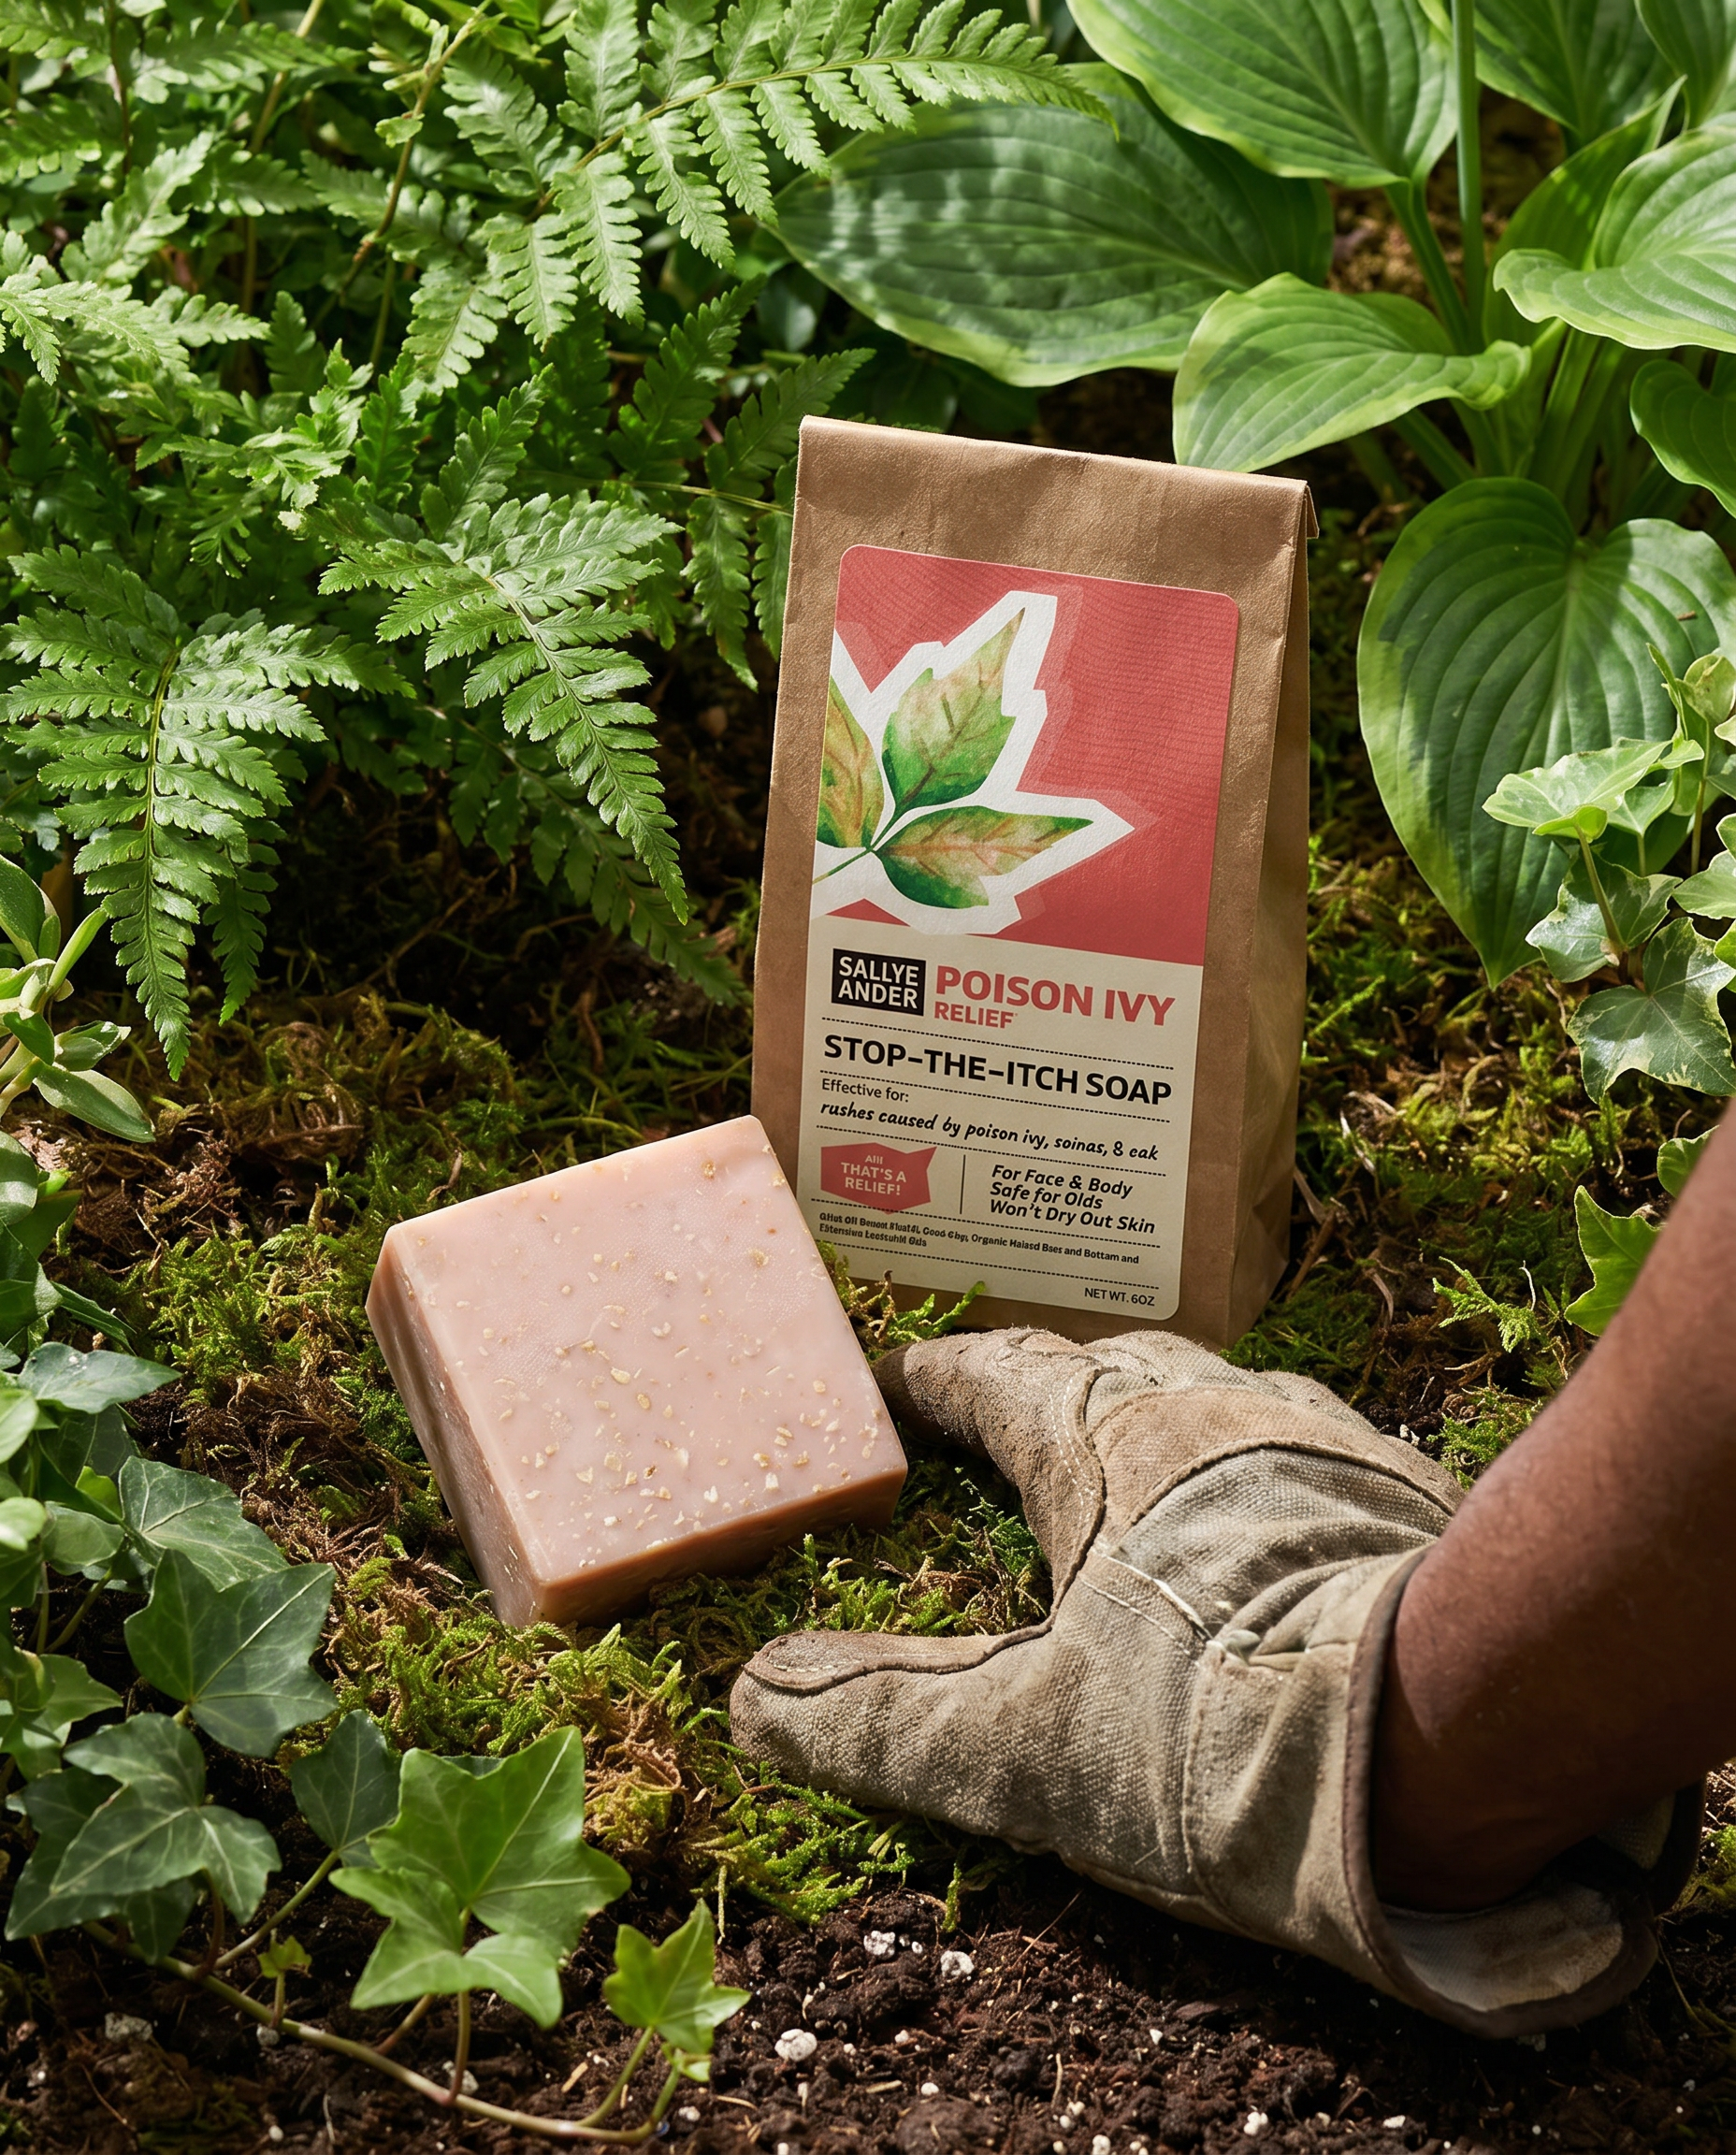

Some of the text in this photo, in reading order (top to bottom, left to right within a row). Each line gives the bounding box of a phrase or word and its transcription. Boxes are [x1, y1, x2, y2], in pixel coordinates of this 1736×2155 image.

[839, 956, 919, 988] SALLYE
[838, 979, 919, 1009] ANDER
[935, 964, 1177, 1026] POISON IVY
[934, 1001, 1015, 1029] RELIEF
[821, 1078, 909, 1103] Effective for:
[1085, 1072, 1172, 1106] SOAP
[820, 1101, 875, 1121] rushes
[878, 1111, 938, 1131] caused
[942, 1116, 961, 1138] by
[964, 1123, 1019, 1141] poison
[1022, 1129, 1049, 1150] ivy,
[1053, 1136, 1108, 1157] soinas,
[841, 1162, 907, 1183] THAT'S A
[845, 1177, 901, 1196] RELIEF!
[991, 1164, 1133, 1199] For Face & Body
[990, 1181, 1104, 1209] Safe for Olds
[991, 1199, 1155, 1234] Won't Dry Out Skin
[971, 1233, 1007, 1247] Organic
[1064, 1247, 1082, 1257] and
[1121, 1254, 1139, 1265] and
[1084, 1287, 1107, 1300] NET
[1108, 1290, 1129, 1303] WT.
